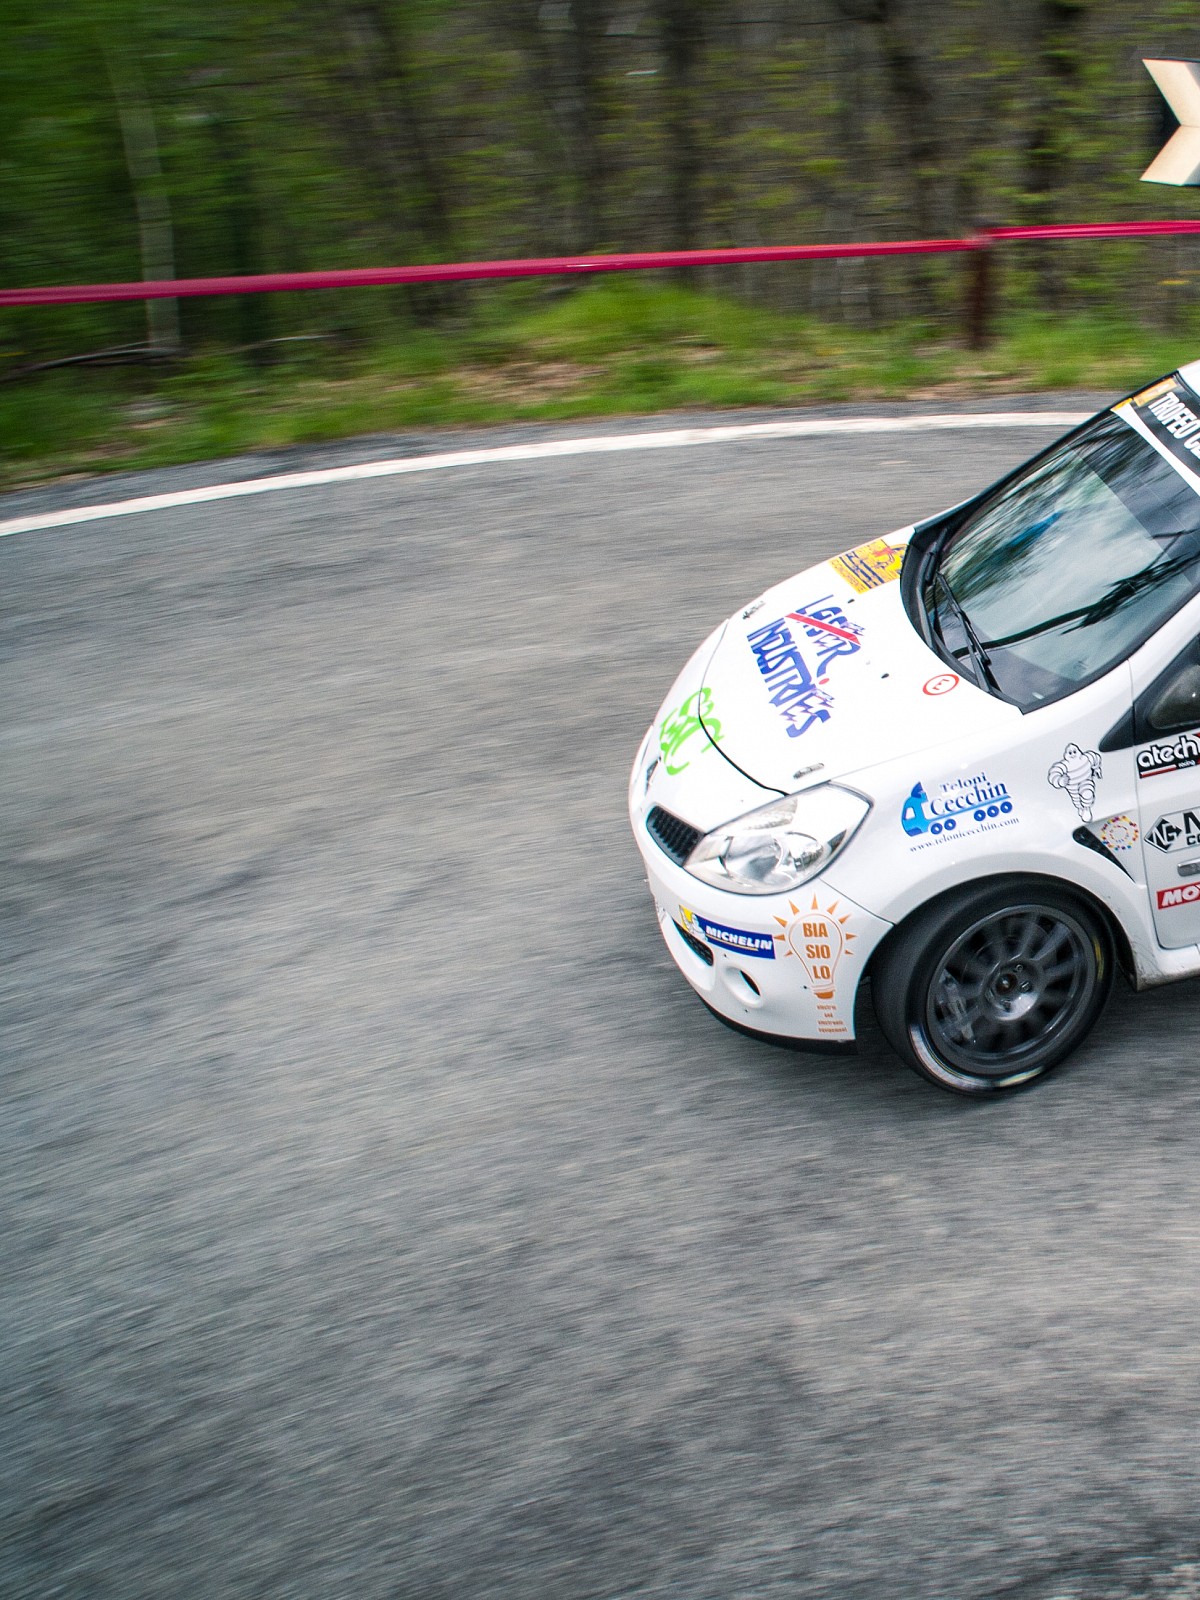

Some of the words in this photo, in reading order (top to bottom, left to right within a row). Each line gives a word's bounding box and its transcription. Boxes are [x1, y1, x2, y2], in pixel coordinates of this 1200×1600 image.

[747, 618, 835, 738] INDUSTRIES
[1137, 735, 1200, 768] atech
[941, 772, 987, 793] Teloni
[930, 782, 1008, 815] Cecchin
[706, 925, 773, 949] MICHELIN
[803, 922, 828, 938] BIA
[806, 944, 831, 959] SIO
[813, 965, 831, 980] LO
